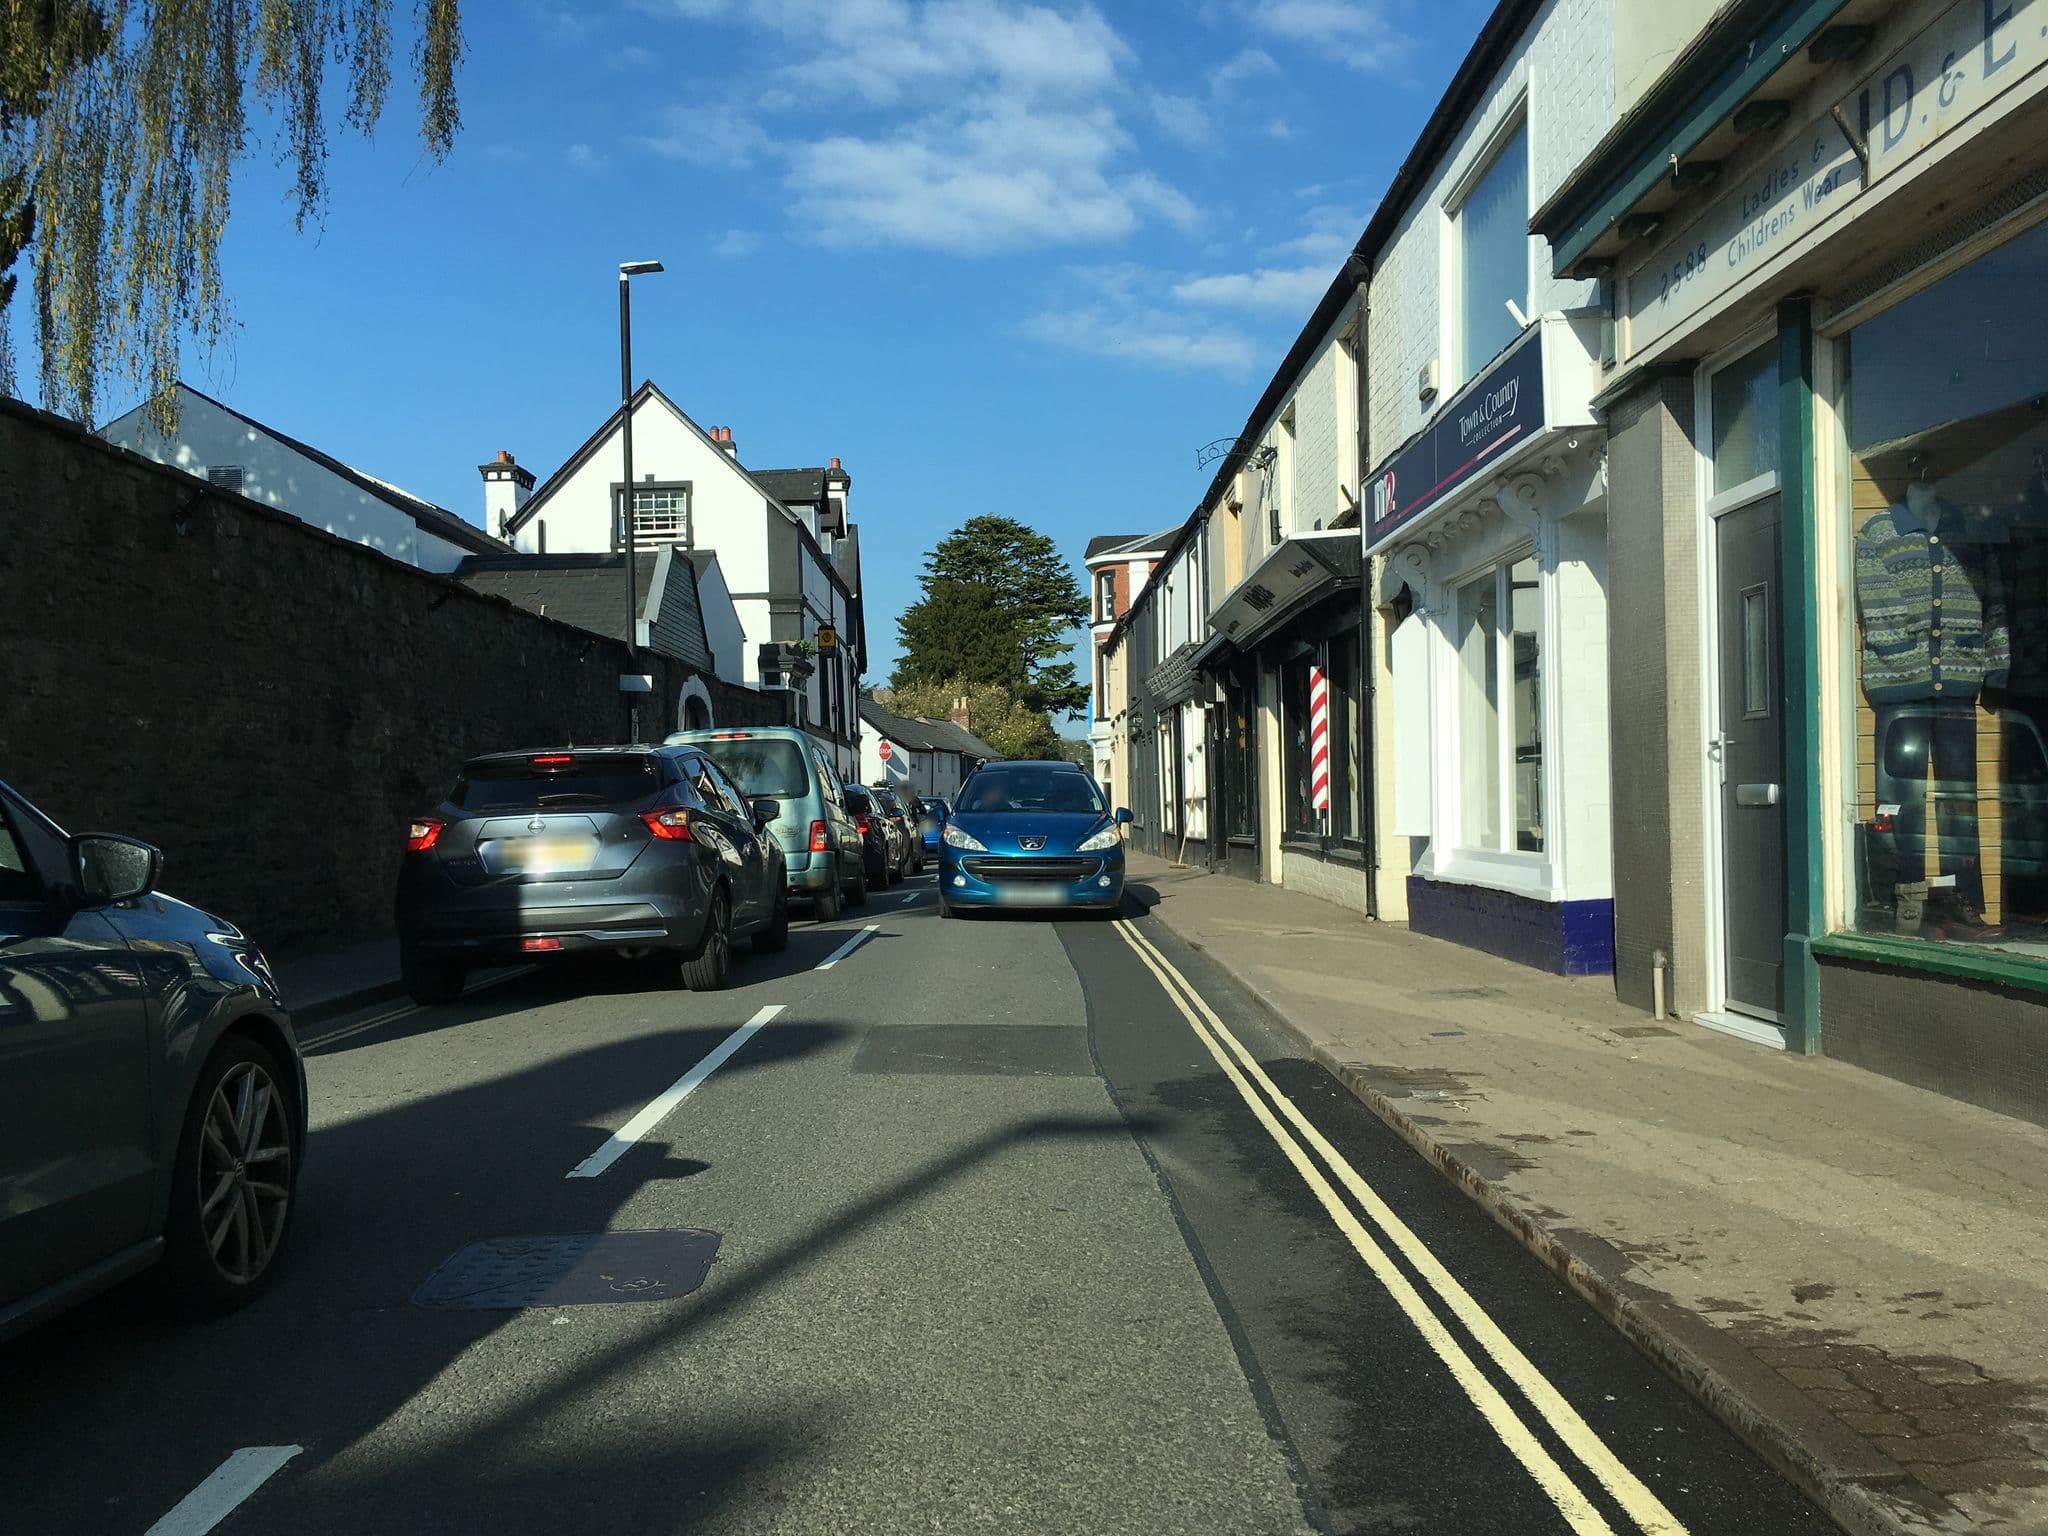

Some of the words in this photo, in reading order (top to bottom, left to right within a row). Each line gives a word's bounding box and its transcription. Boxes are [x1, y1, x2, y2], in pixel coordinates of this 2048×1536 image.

[1938, 51, 1966, 108] &
[1727, 202, 1796, 268] Childrens
[1802, 168, 1842, 209] Wear
[1743, 160, 1799, 220] Ladies
[1660, 242, 1708, 306] 2588
[1472, 414, 1503, 444] COLLECTION
